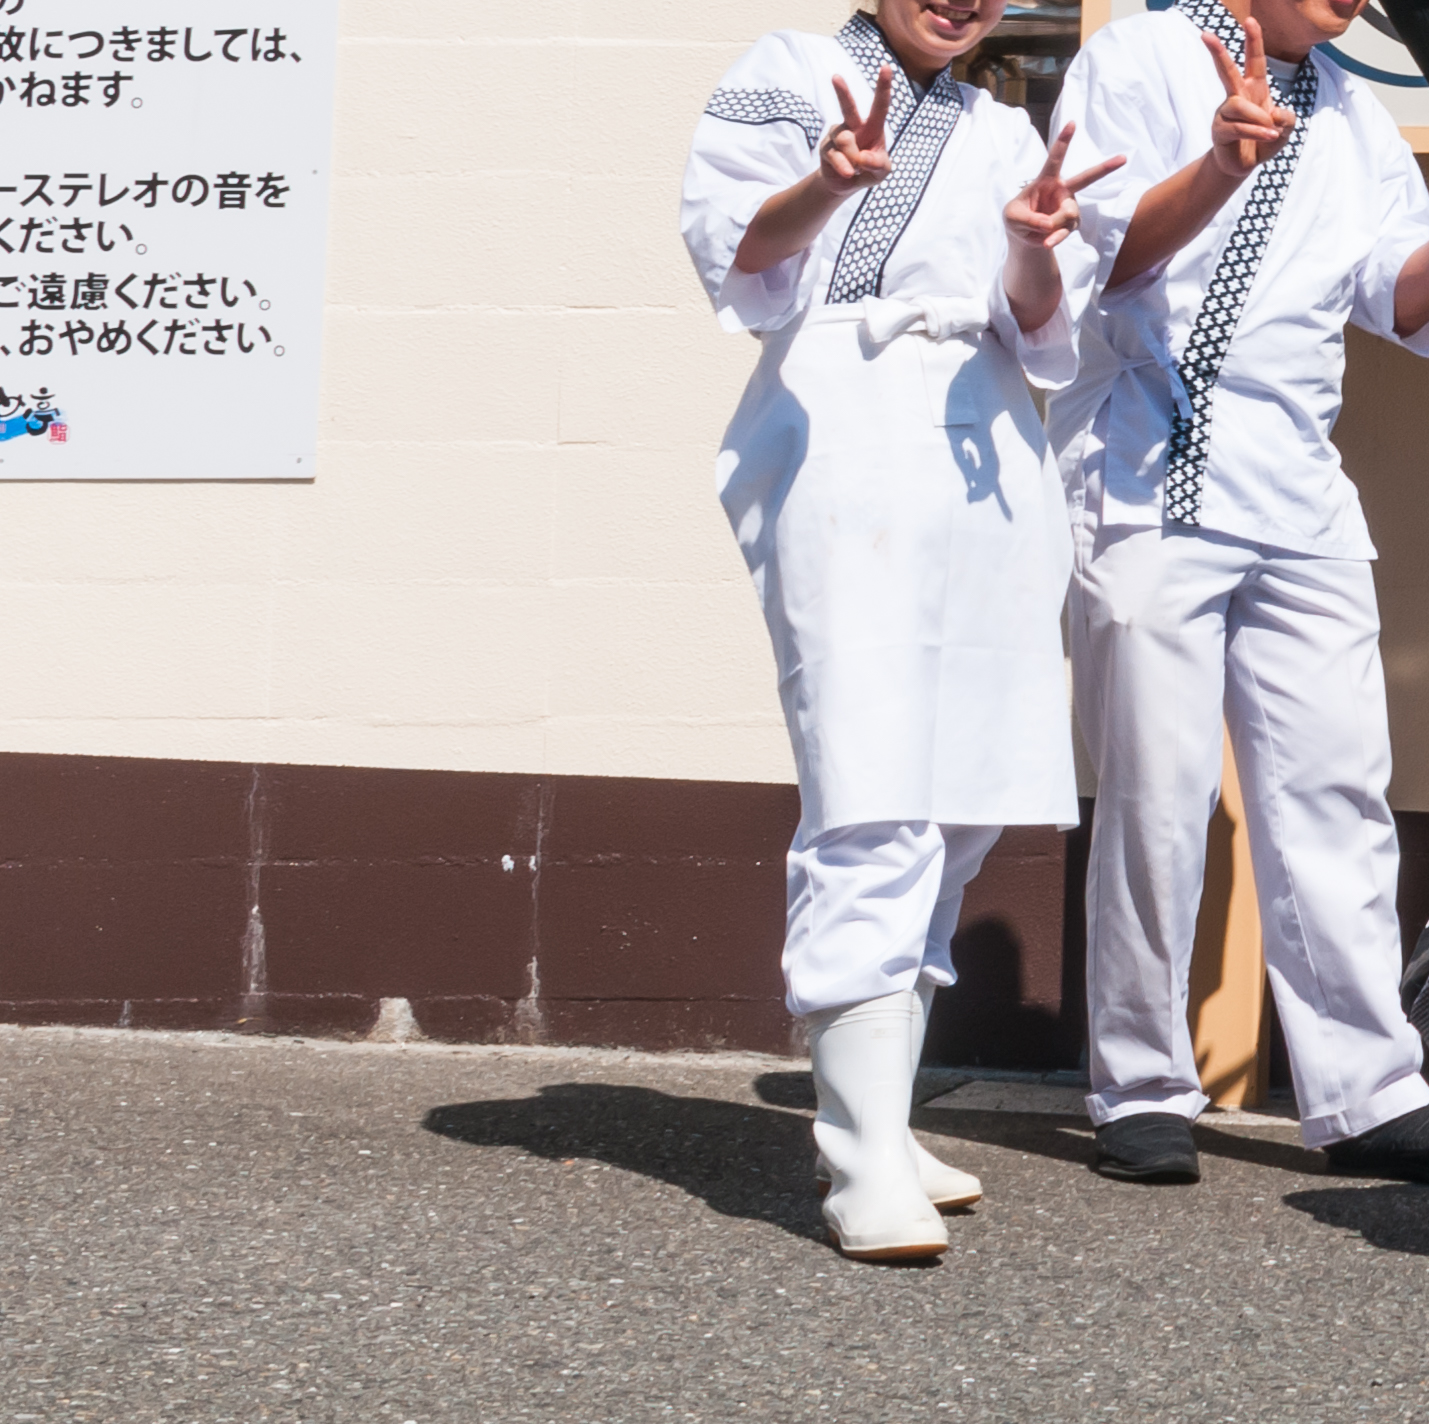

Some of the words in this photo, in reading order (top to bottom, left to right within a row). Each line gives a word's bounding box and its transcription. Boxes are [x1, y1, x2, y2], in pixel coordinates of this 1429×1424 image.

[0, 272, 271, 311] ご遠慮ください。
